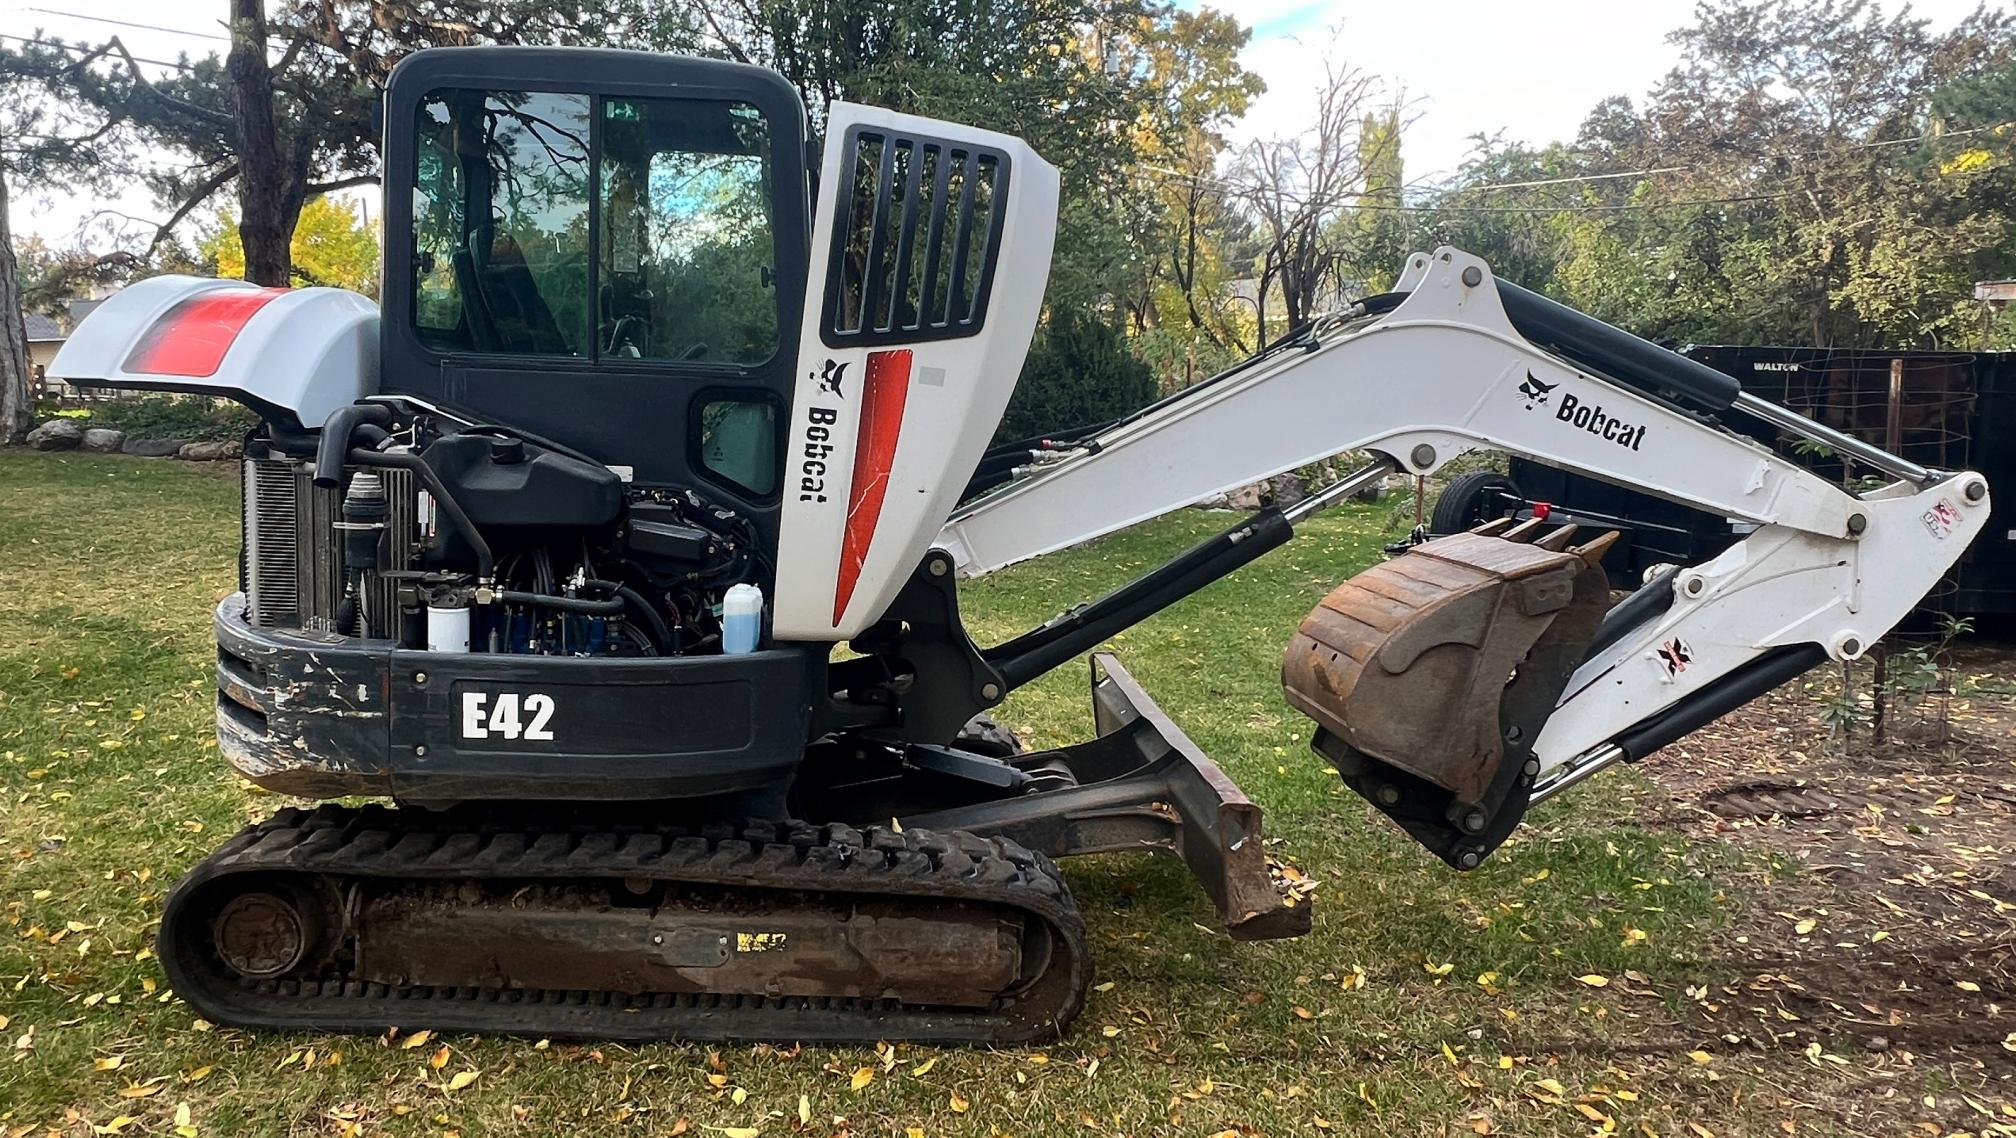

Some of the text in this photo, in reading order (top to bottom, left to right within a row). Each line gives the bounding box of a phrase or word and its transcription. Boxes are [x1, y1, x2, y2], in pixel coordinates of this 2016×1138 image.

[1753, 362, 1799, 372] WALTON
[1556, 392, 1647, 452] Bobcat
[462, 692, 555, 741] E42
